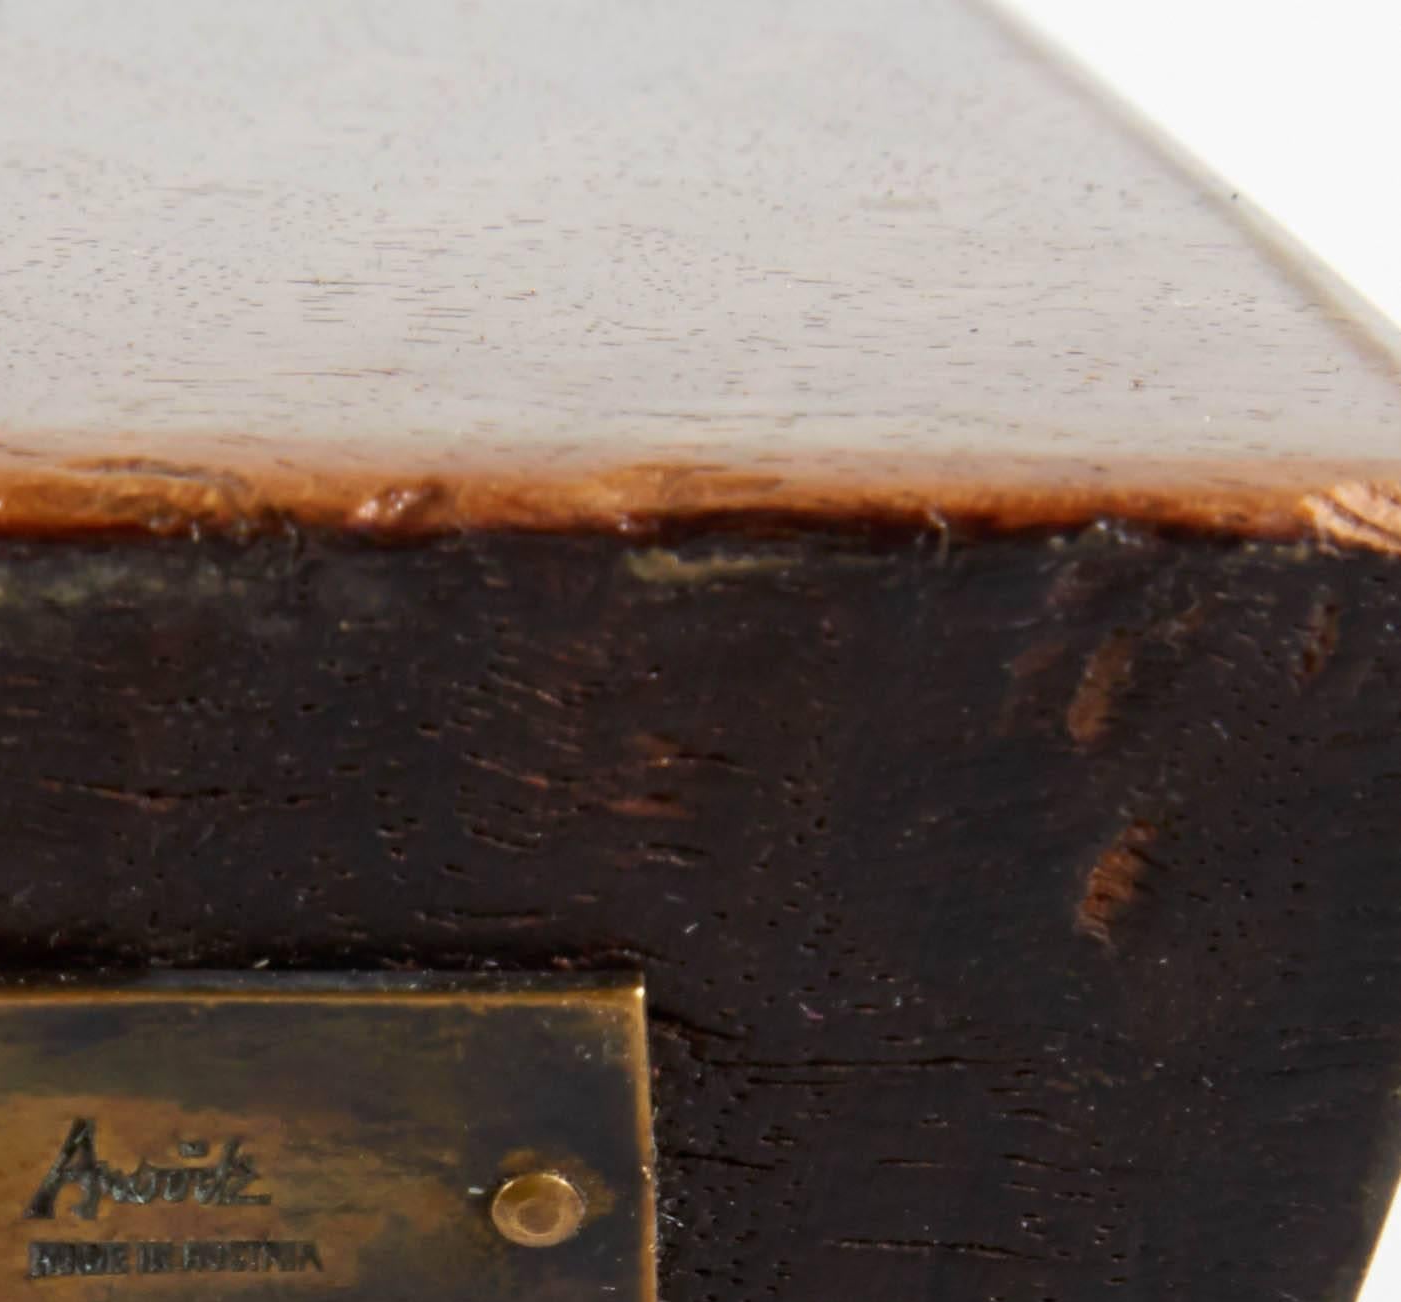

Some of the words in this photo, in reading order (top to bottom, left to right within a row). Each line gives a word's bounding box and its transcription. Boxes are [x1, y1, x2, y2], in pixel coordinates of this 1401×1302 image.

[29, 1241, 129, 1278] MADE
[136, 1240, 173, 1273] IN
[183, 1240, 324, 1273] AUSTRIA
